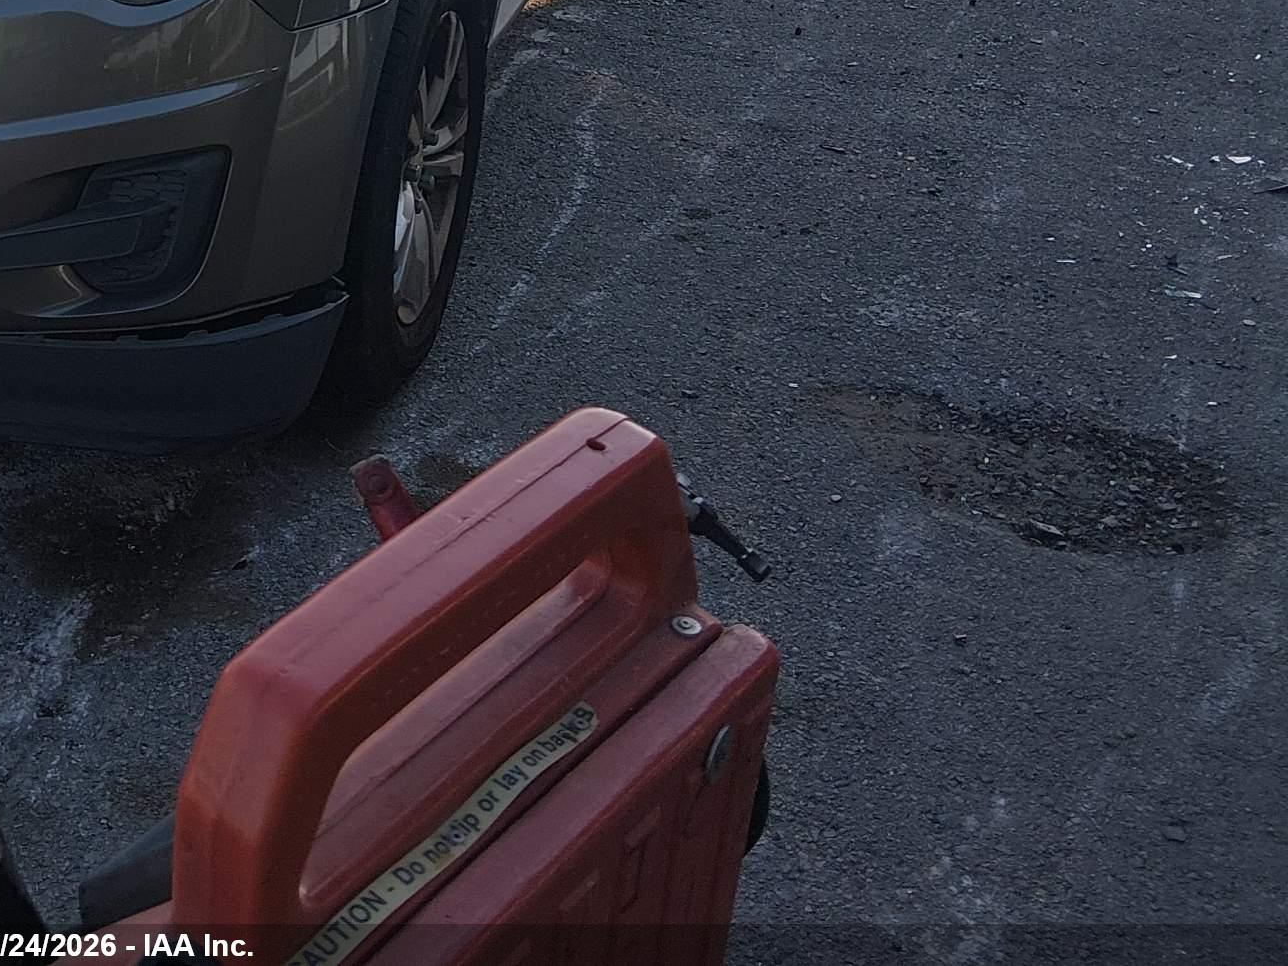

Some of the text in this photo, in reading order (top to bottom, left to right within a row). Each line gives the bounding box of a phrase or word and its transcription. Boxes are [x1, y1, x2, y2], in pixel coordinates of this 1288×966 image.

[286, 890, 388, 966] AUTION
[391, 857, 426, 887] Do
[477, 790, 501, 813] or
[492, 767, 528, 792] lay
[522, 749, 548, 767] on
